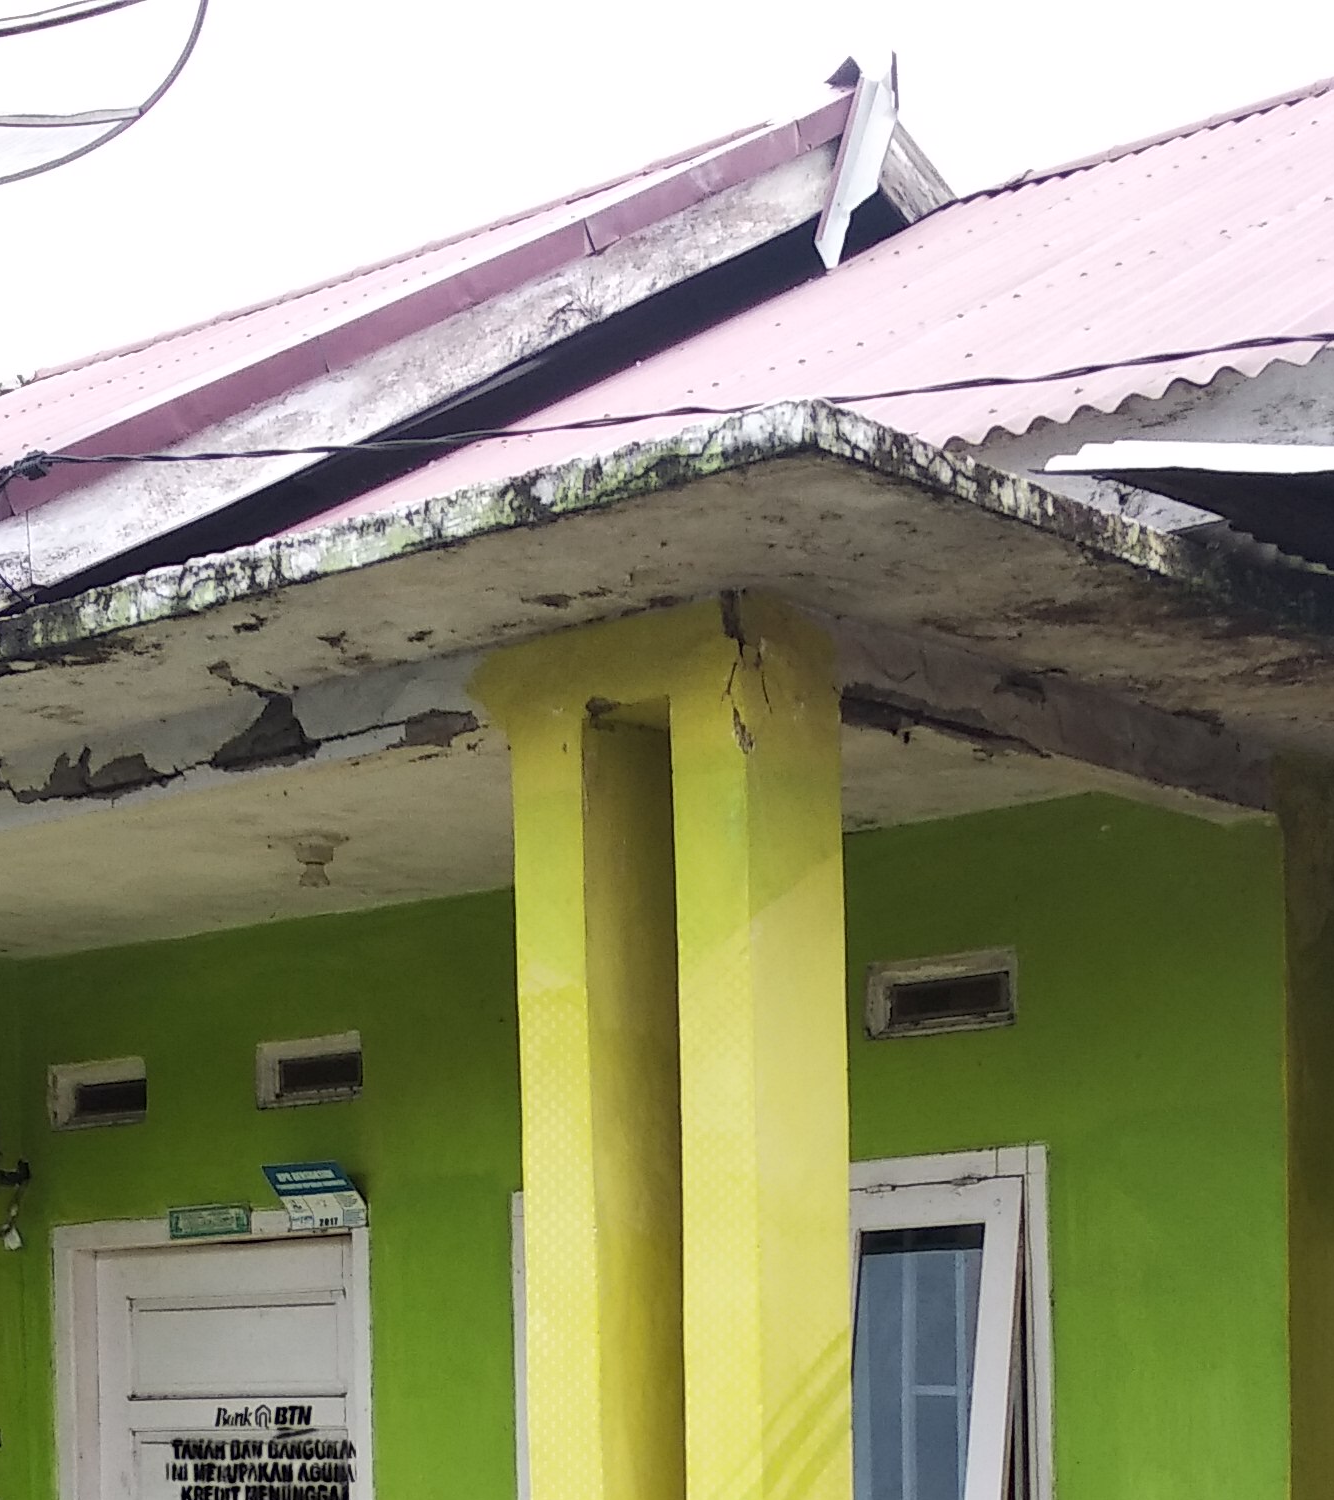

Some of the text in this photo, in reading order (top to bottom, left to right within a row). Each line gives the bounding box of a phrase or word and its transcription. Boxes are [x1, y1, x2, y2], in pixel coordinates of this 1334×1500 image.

[215, 1405, 312, 1427] Bank BTN
[171, 1439, 357, 1460] TANAH DAN BANGUNAN
